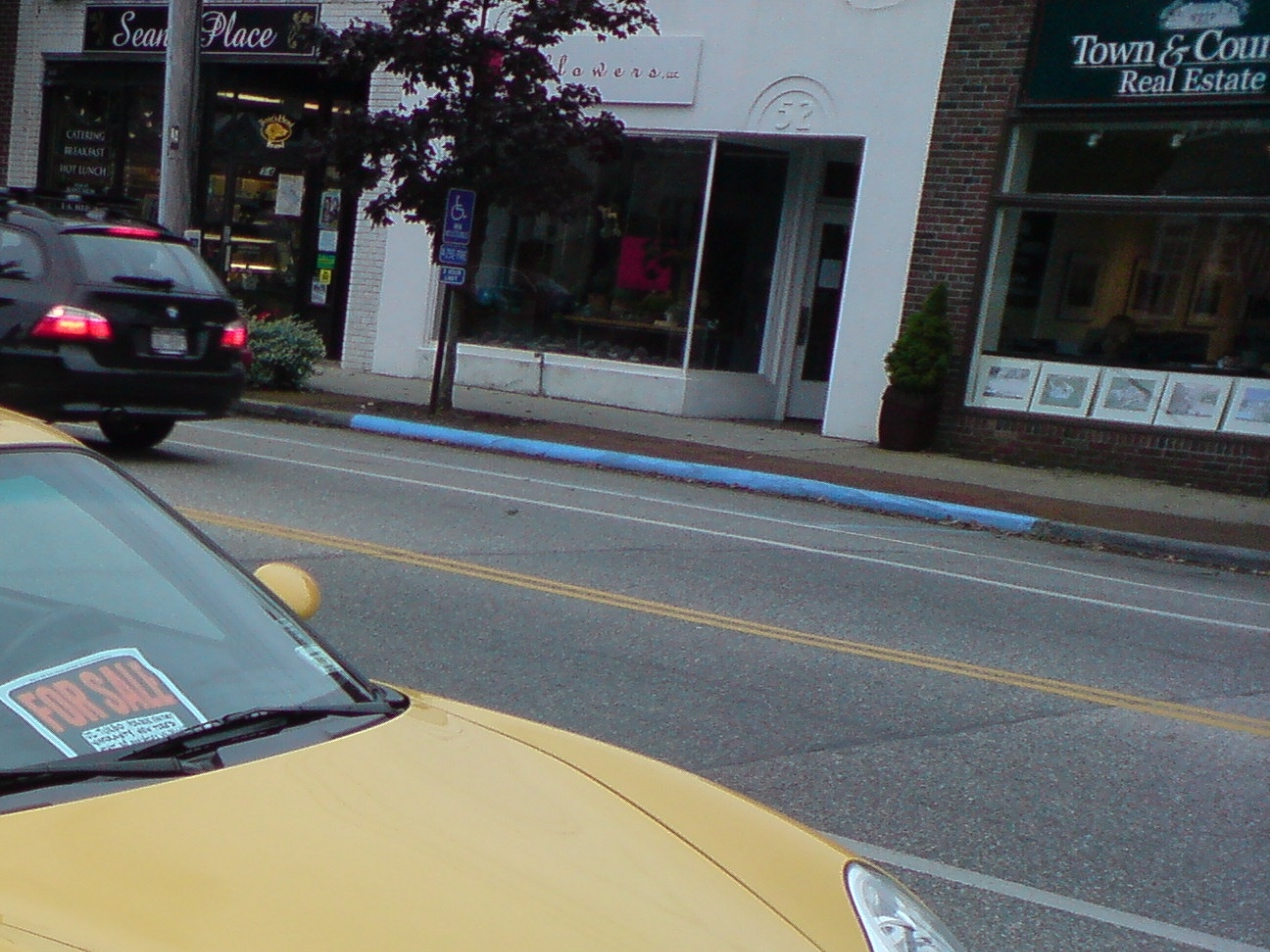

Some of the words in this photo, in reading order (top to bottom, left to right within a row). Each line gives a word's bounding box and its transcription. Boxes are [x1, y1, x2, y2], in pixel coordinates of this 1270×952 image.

[112, 11, 168, 47] Sean
[201, 11, 277, 48] Place
[1072, 34, 1156, 66] Town
[1158, 34, 1190, 68] &
[1117, 67, 1177, 94] Real
[1181, 67, 1267, 92] Estate
[775, 102, 813, 131] 52
[65, 130, 106, 141] CATERING
[63, 146, 106, 157] BREAKFAST
[59, 164, 77, 174] HOT
[78, 165, 107, 177] LUNCH
[17, 680, 110, 734] FOR
[79, 660, 179, 715] SALE
